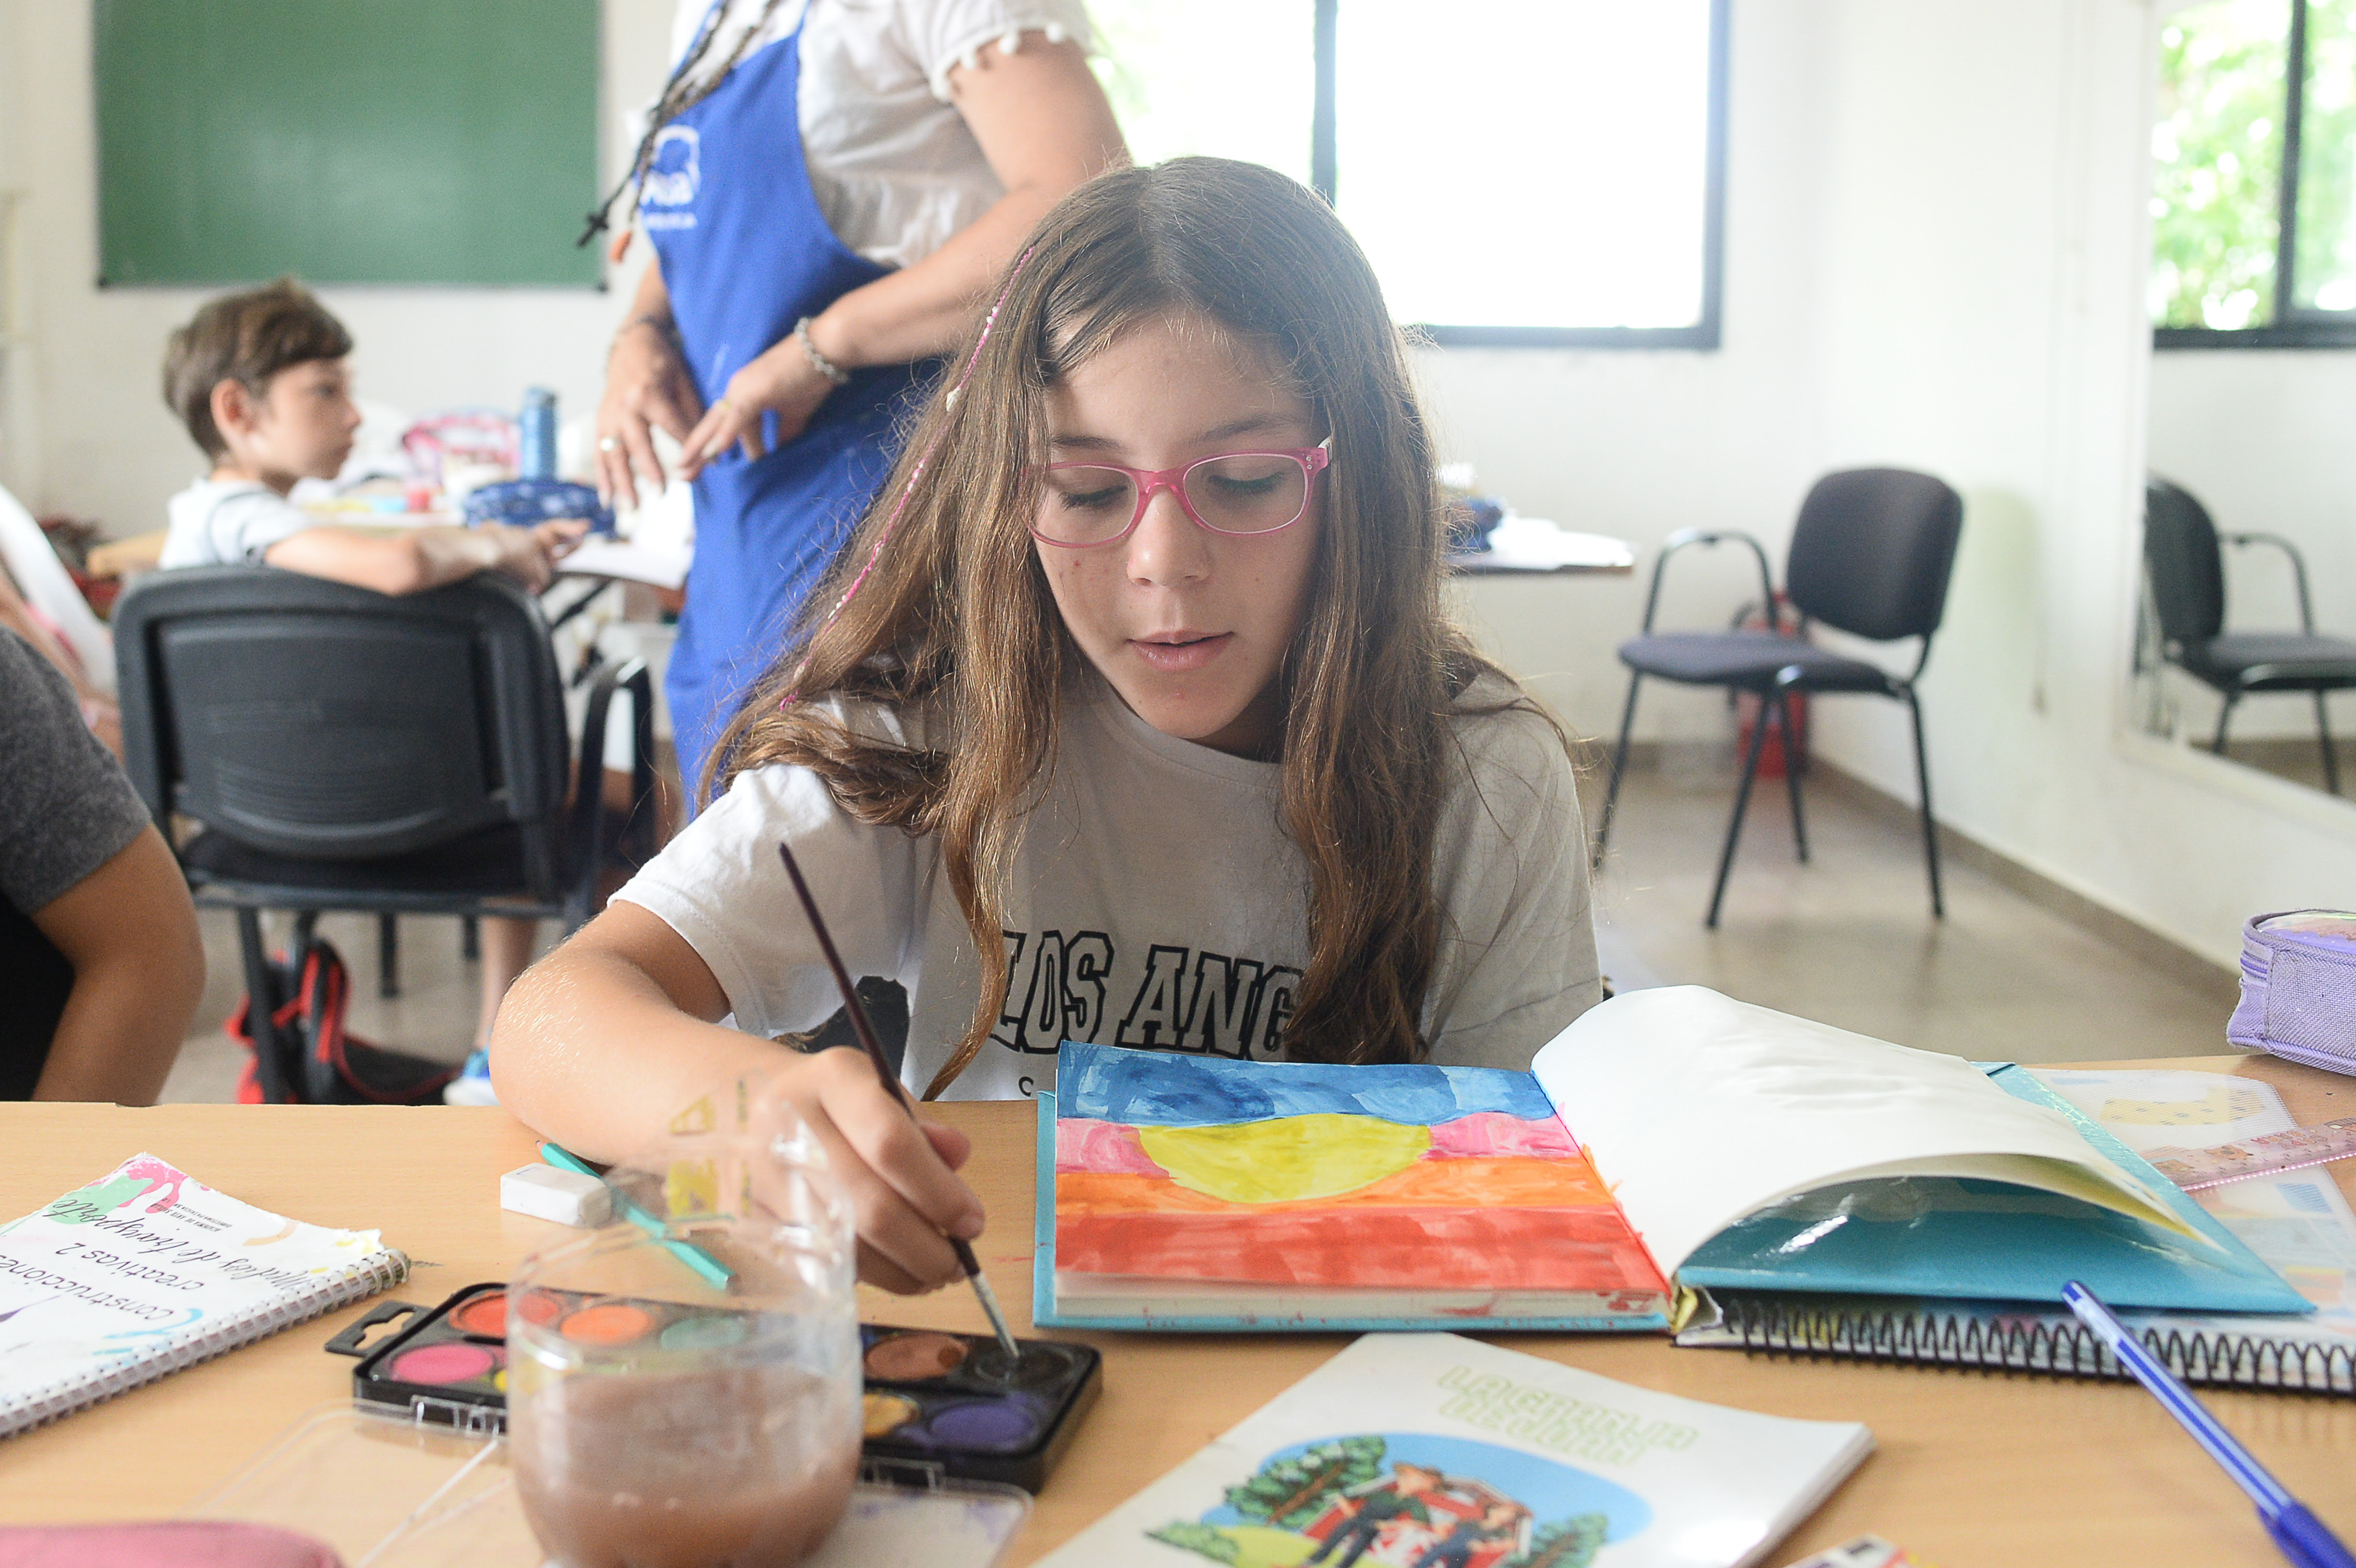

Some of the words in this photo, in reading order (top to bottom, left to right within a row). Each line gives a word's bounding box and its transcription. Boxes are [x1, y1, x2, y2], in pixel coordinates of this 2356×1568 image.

[991, 930, 1114, 1054] LOS
[1115, 944, 1304, 1061] ANG
[42, 1199, 190, 1254] transporte
[55, 1242, 86, 1254] 2
[172, 1250, 221, 1263] de
[81, 1250, 204, 1290] creativas
